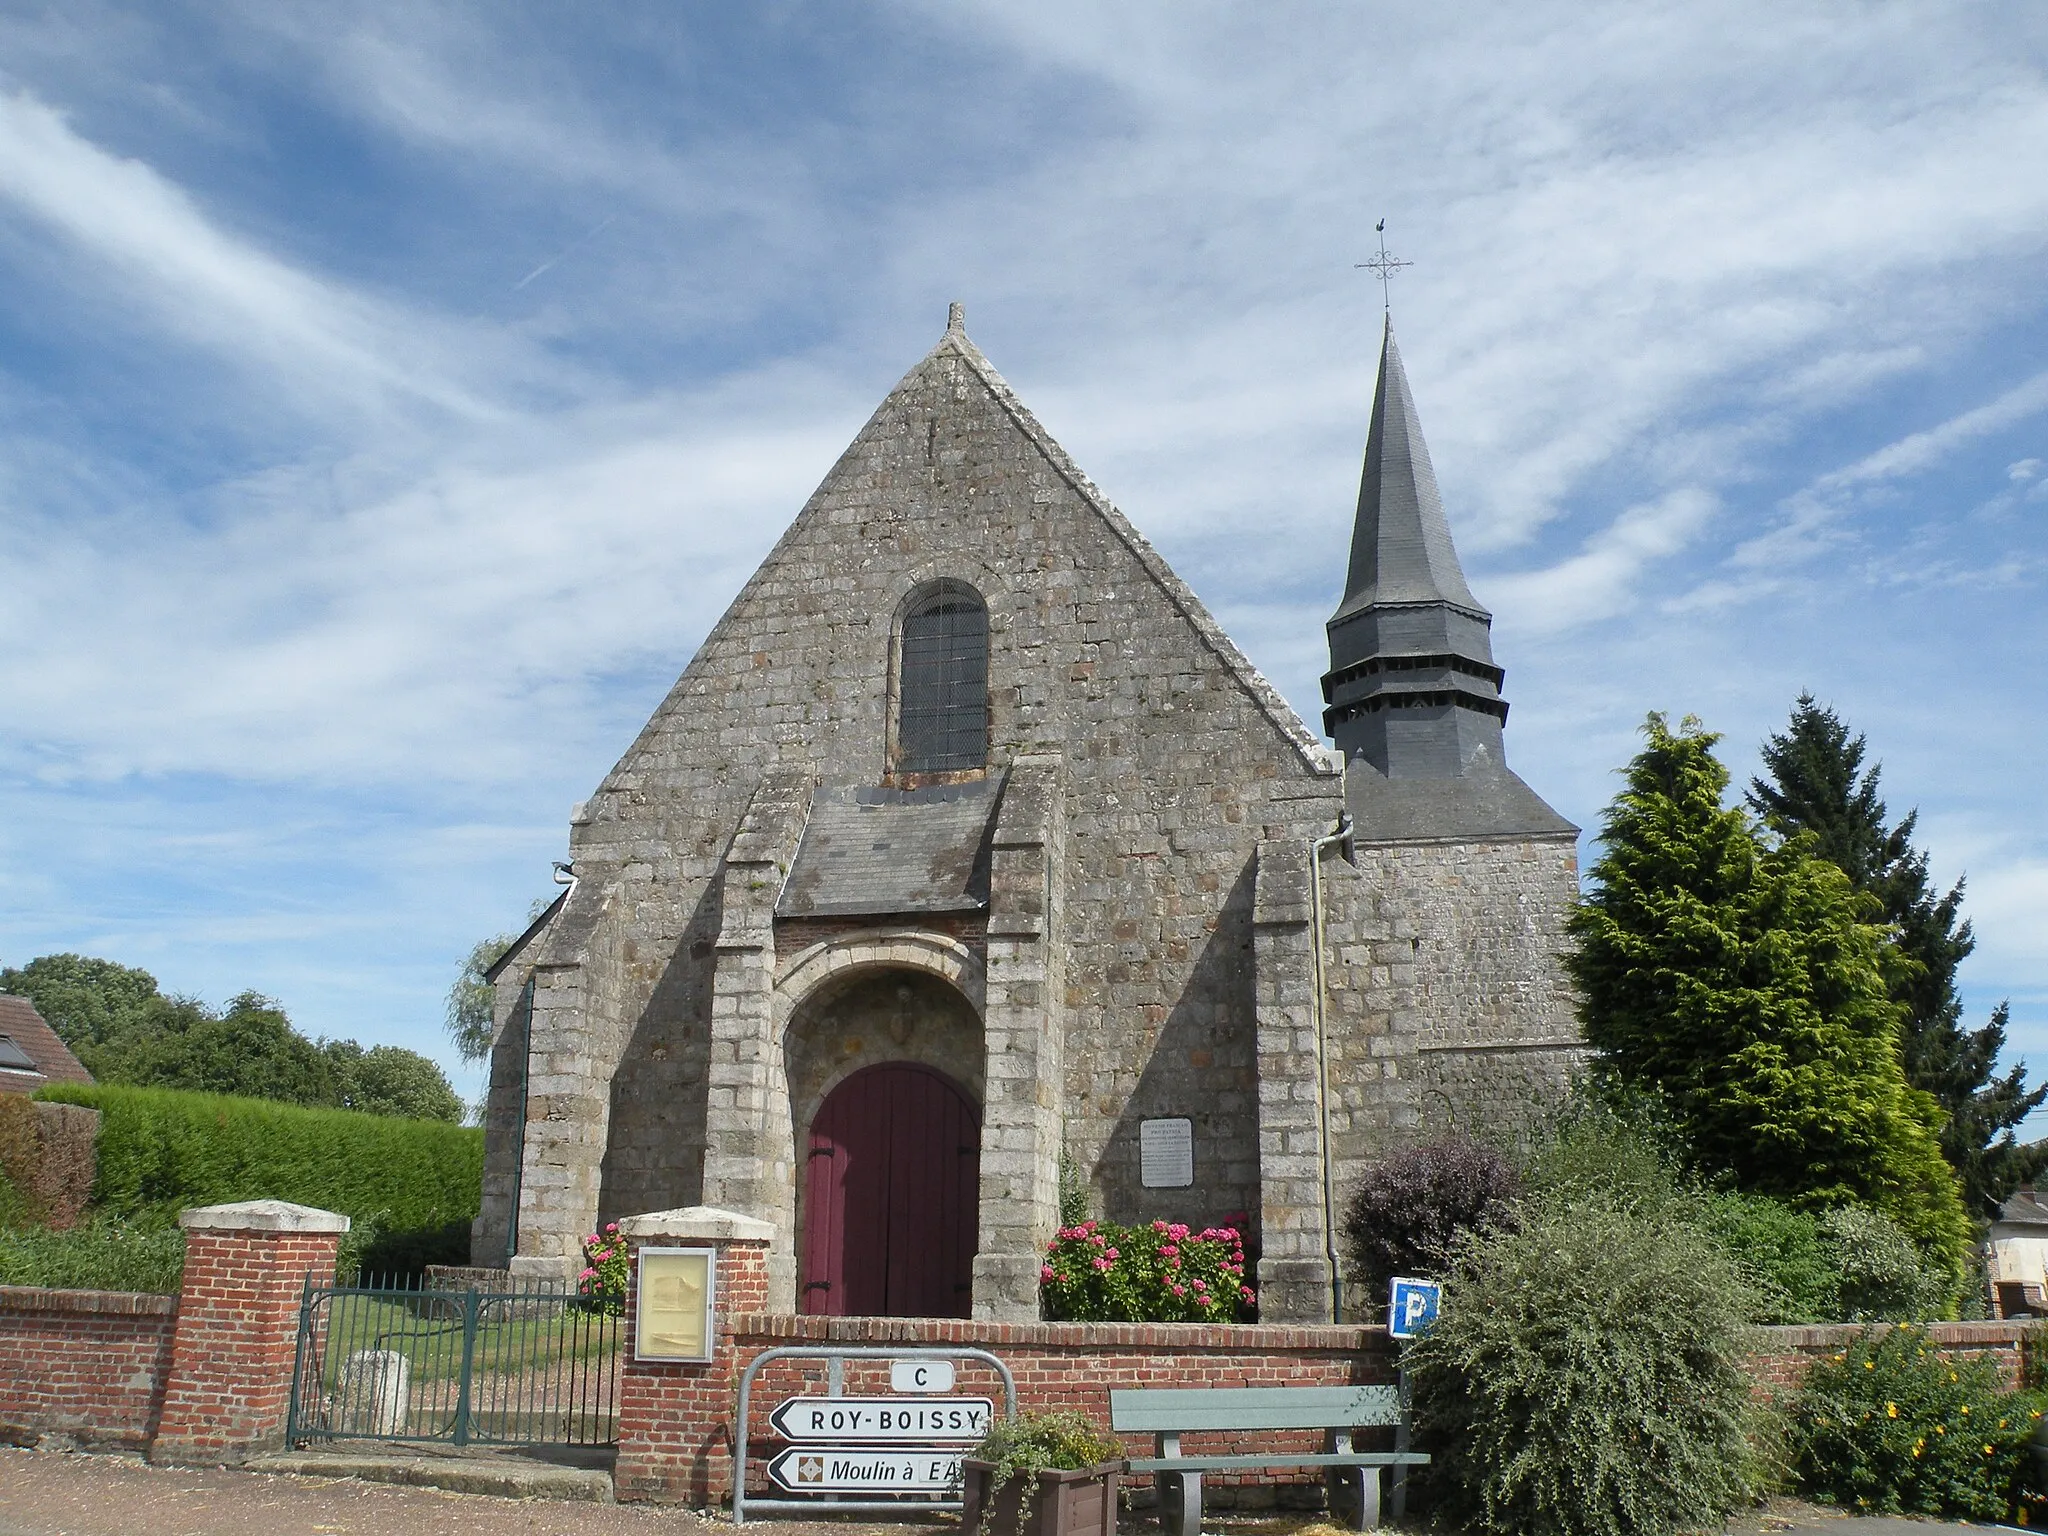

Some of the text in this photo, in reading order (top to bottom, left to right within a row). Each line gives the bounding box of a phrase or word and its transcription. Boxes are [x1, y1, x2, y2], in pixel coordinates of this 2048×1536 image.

[1405, 1292, 1427, 1326] P
[914, 1367, 928, 1386] C
[811, 1410, 981, 1430] ROY-BOISSY
[830, 1460, 958, 1481] Moulin à EA
